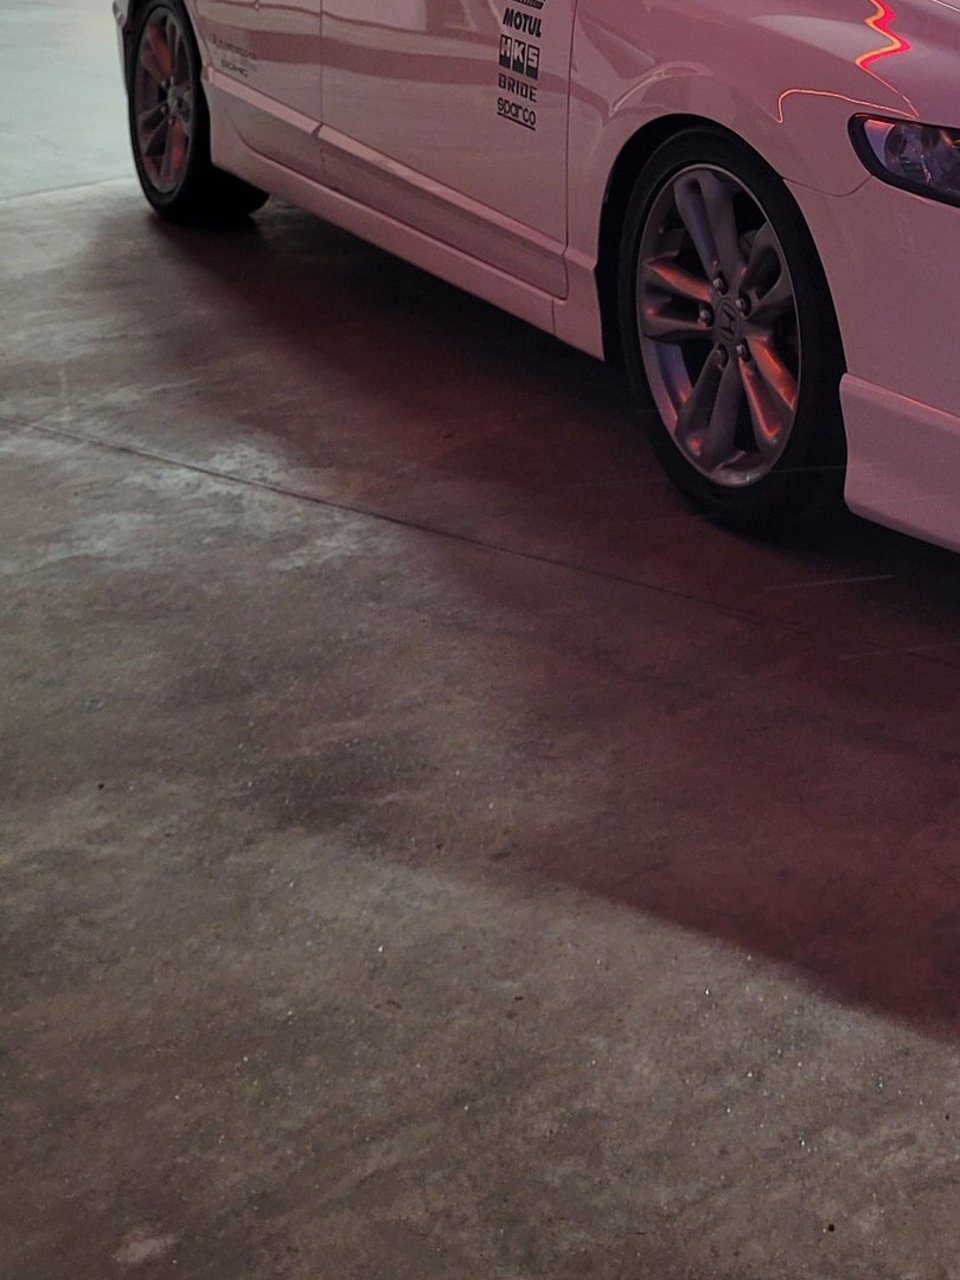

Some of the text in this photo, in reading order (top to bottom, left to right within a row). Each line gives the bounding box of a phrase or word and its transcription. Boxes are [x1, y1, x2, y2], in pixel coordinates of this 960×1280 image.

[502, 7, 542, 38] MOTUL
[499, 35, 540, 72] HKS
[498, 73, 538, 102] BRIDE
[497, 96, 537, 127] sparco
